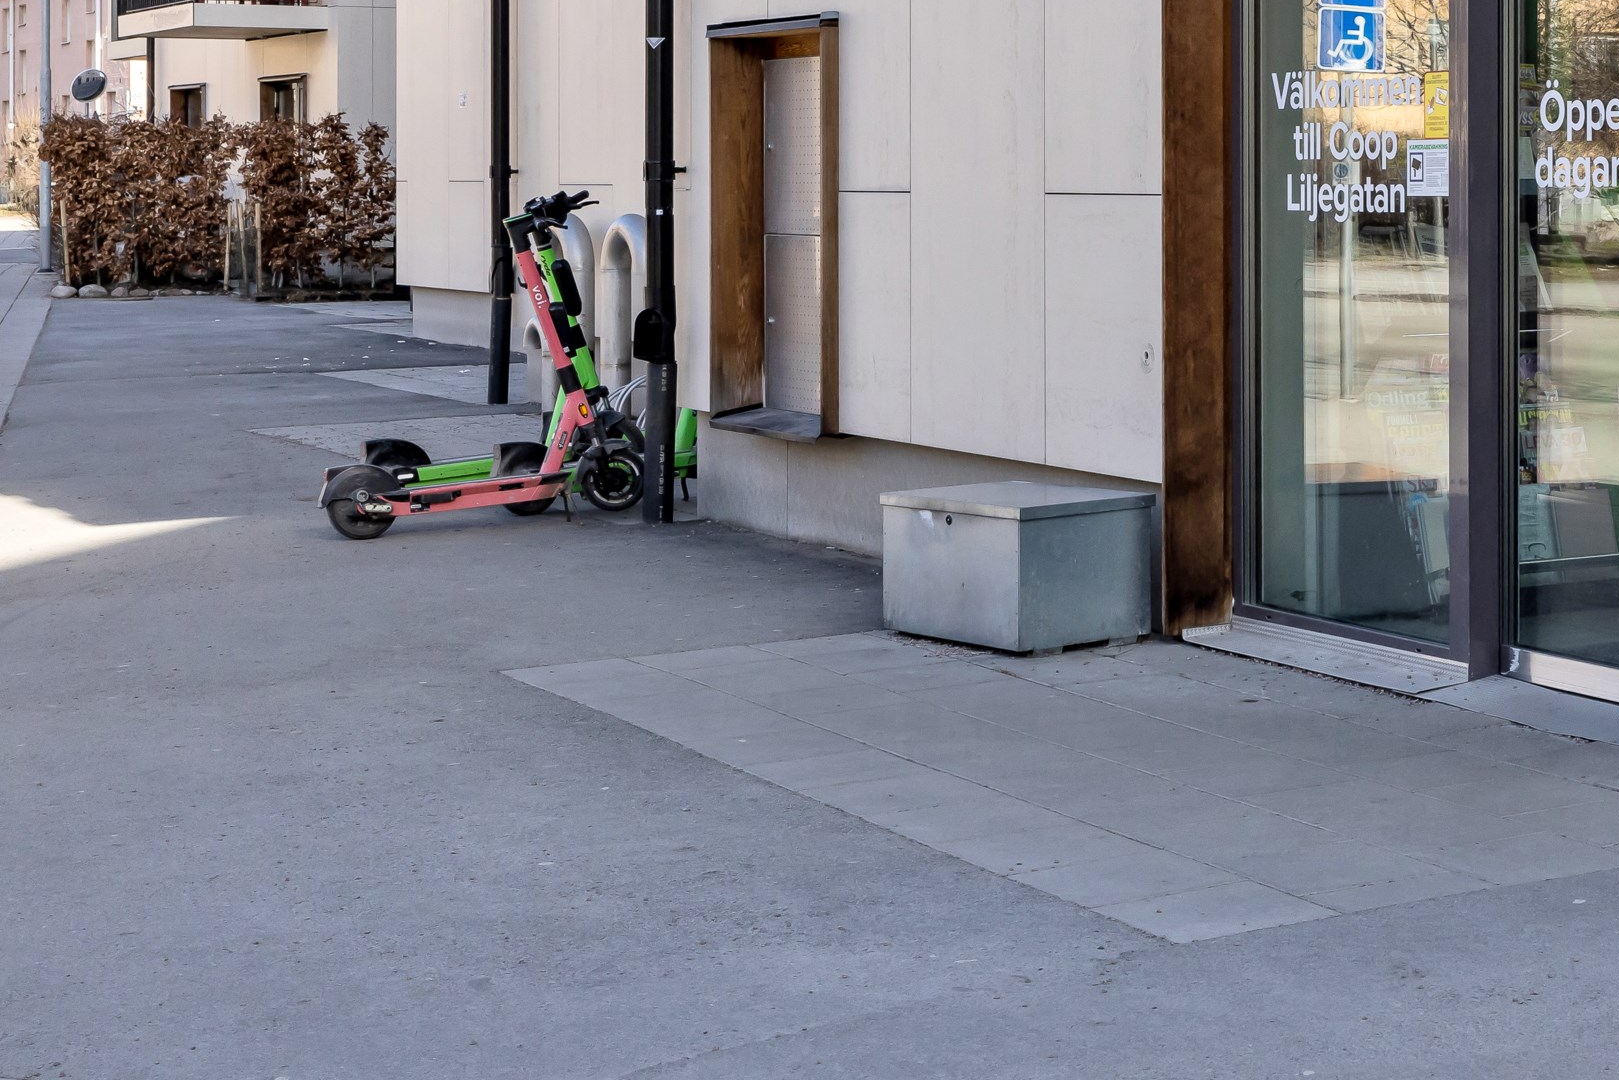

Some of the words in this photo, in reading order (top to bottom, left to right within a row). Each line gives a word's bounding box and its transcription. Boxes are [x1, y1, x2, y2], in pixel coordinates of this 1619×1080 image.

[1271, 71, 1421, 110] Välkommen
[1293, 122, 1321, 161] till
[1329, 121, 1398, 170] Coop
[1286, 173, 1406, 222] Liljegatan
